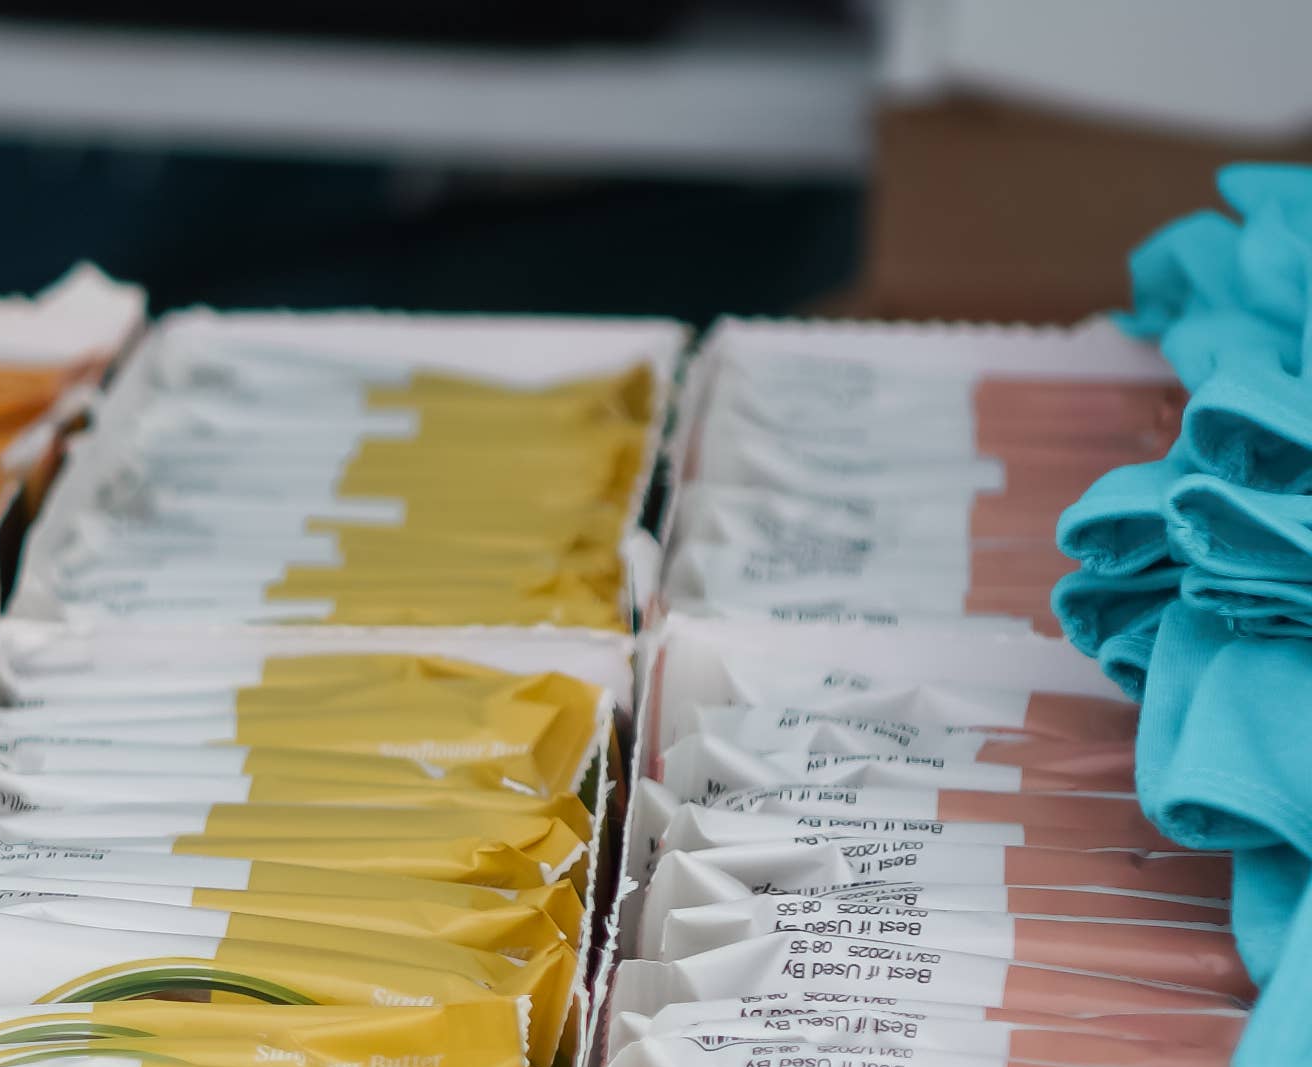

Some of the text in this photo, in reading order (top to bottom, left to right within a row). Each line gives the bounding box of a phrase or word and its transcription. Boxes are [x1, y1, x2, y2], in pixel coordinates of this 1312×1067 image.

[879, 854, 917, 871] Best
[858, 920, 873, 934] if
[879, 920, 922, 936] Best
[781, 962, 933, 984] Best if Used By
